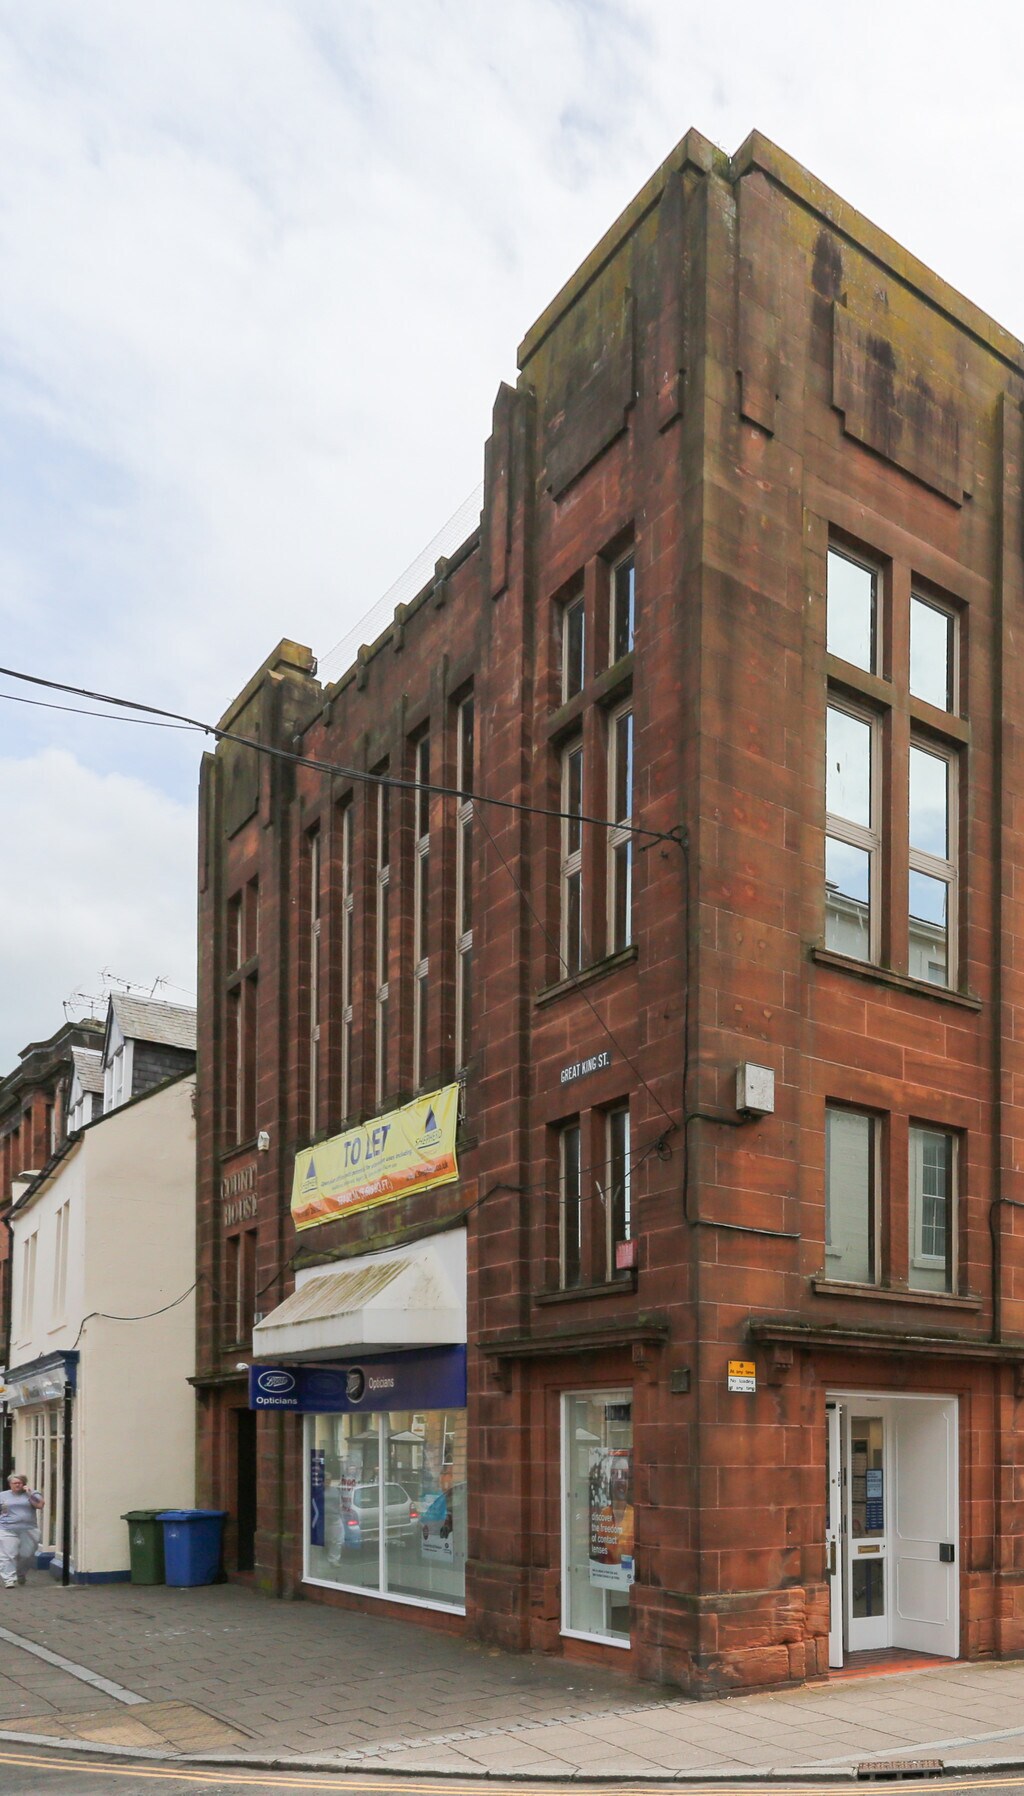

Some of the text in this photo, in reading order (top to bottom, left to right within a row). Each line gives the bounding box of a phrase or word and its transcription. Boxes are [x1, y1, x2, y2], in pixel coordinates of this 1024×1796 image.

[560, 1052, 610, 1083] GREAT KING ST.
[344, 1124, 391, 1168] TO LET
[224, 1192, 258, 1227] HOUSE
[368, 1377, 395, 1390] Opticians
[256, 1396, 298, 1405] Opticians
[591, 1512, 612, 1522] discover
[591, 1523, 623, 1534] the freedom
[591, 1534, 618, 1544] of contact
[591, 1545, 608, 1554] lenses
